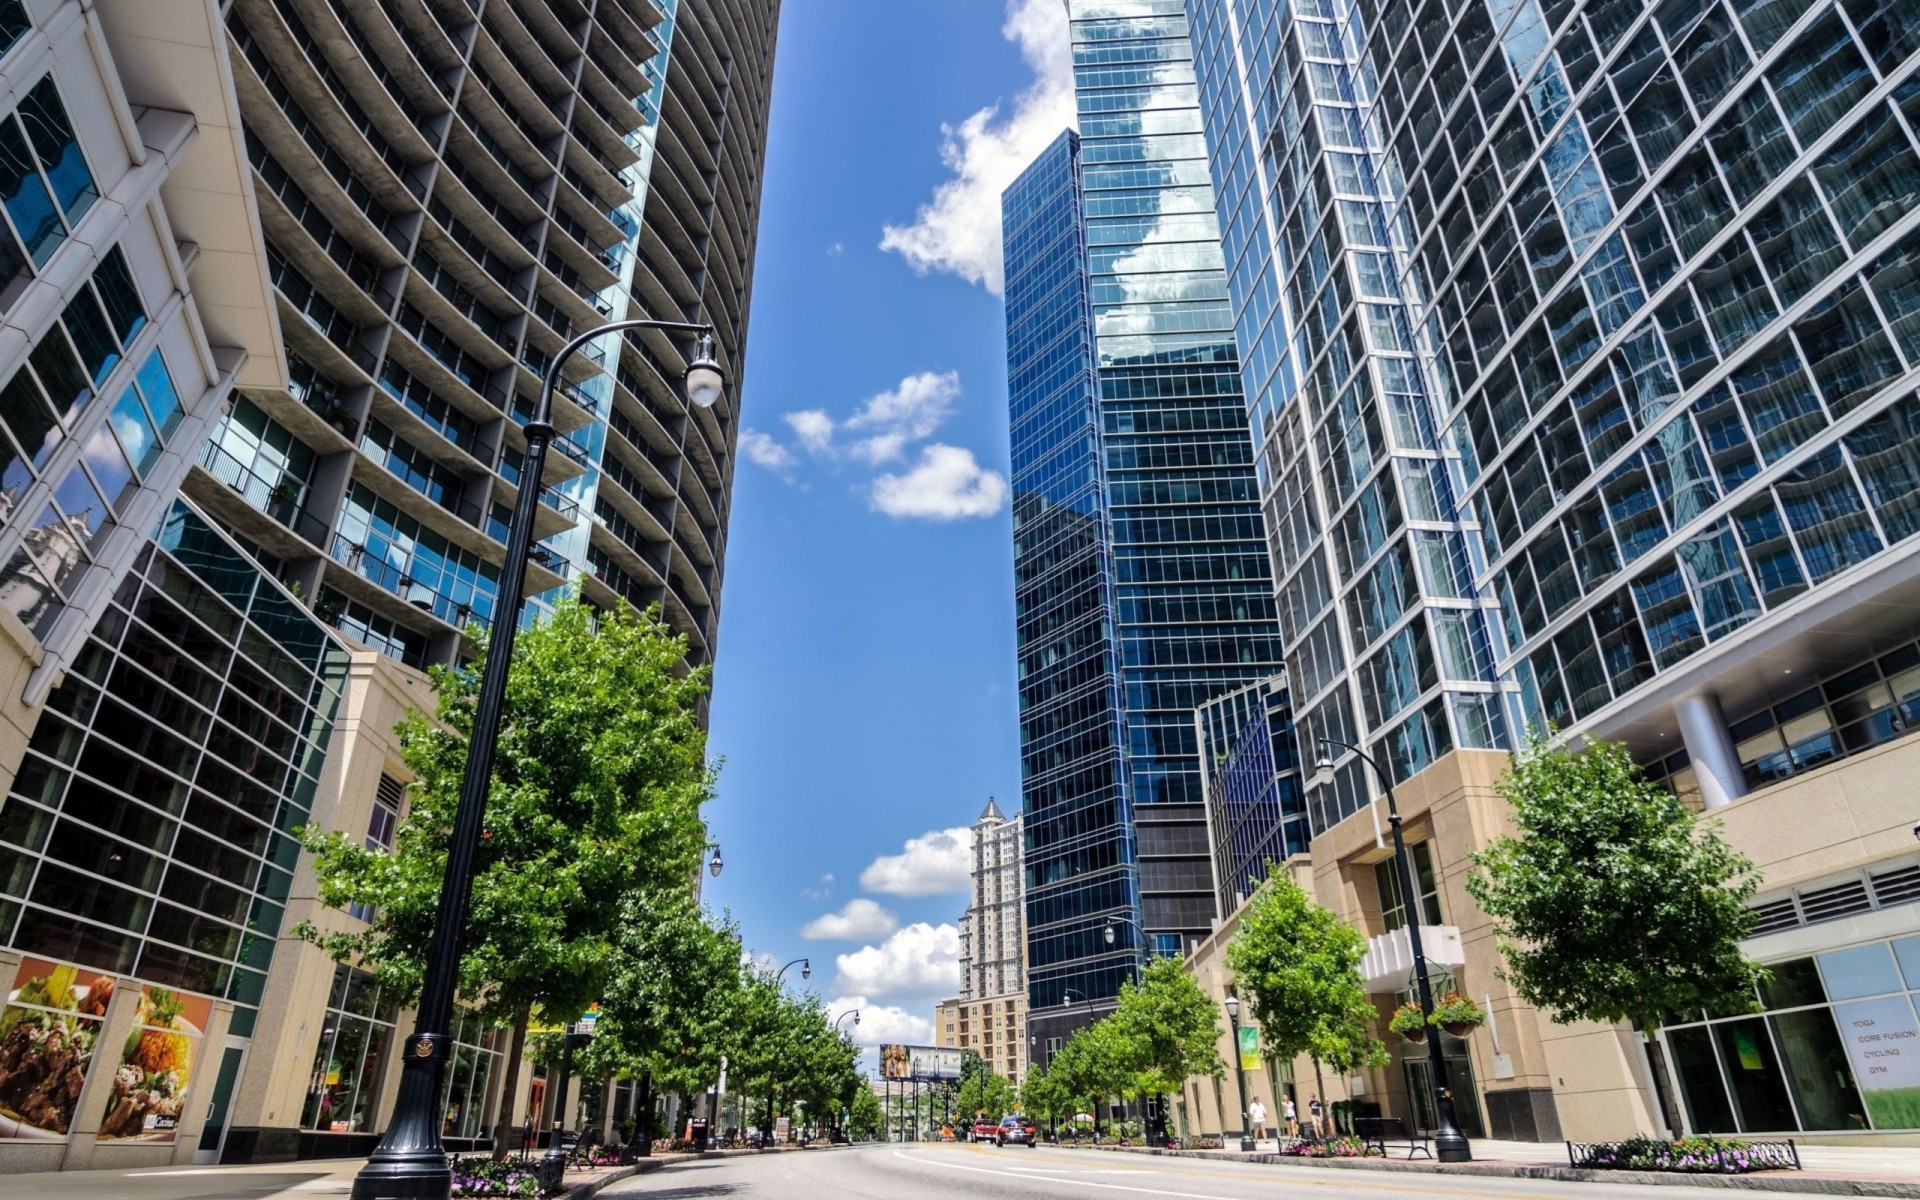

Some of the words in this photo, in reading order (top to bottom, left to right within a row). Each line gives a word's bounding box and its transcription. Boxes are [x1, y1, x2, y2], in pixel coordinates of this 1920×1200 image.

[1852, 1019, 1876, 1028] YOGA
[1858, 1034, 1881, 1043] CORE
[1883, 1031, 1916, 1040] FUSION
[1863, 1048, 1900, 1059] CYCLING
[1869, 1066, 1888, 1074] GYM
